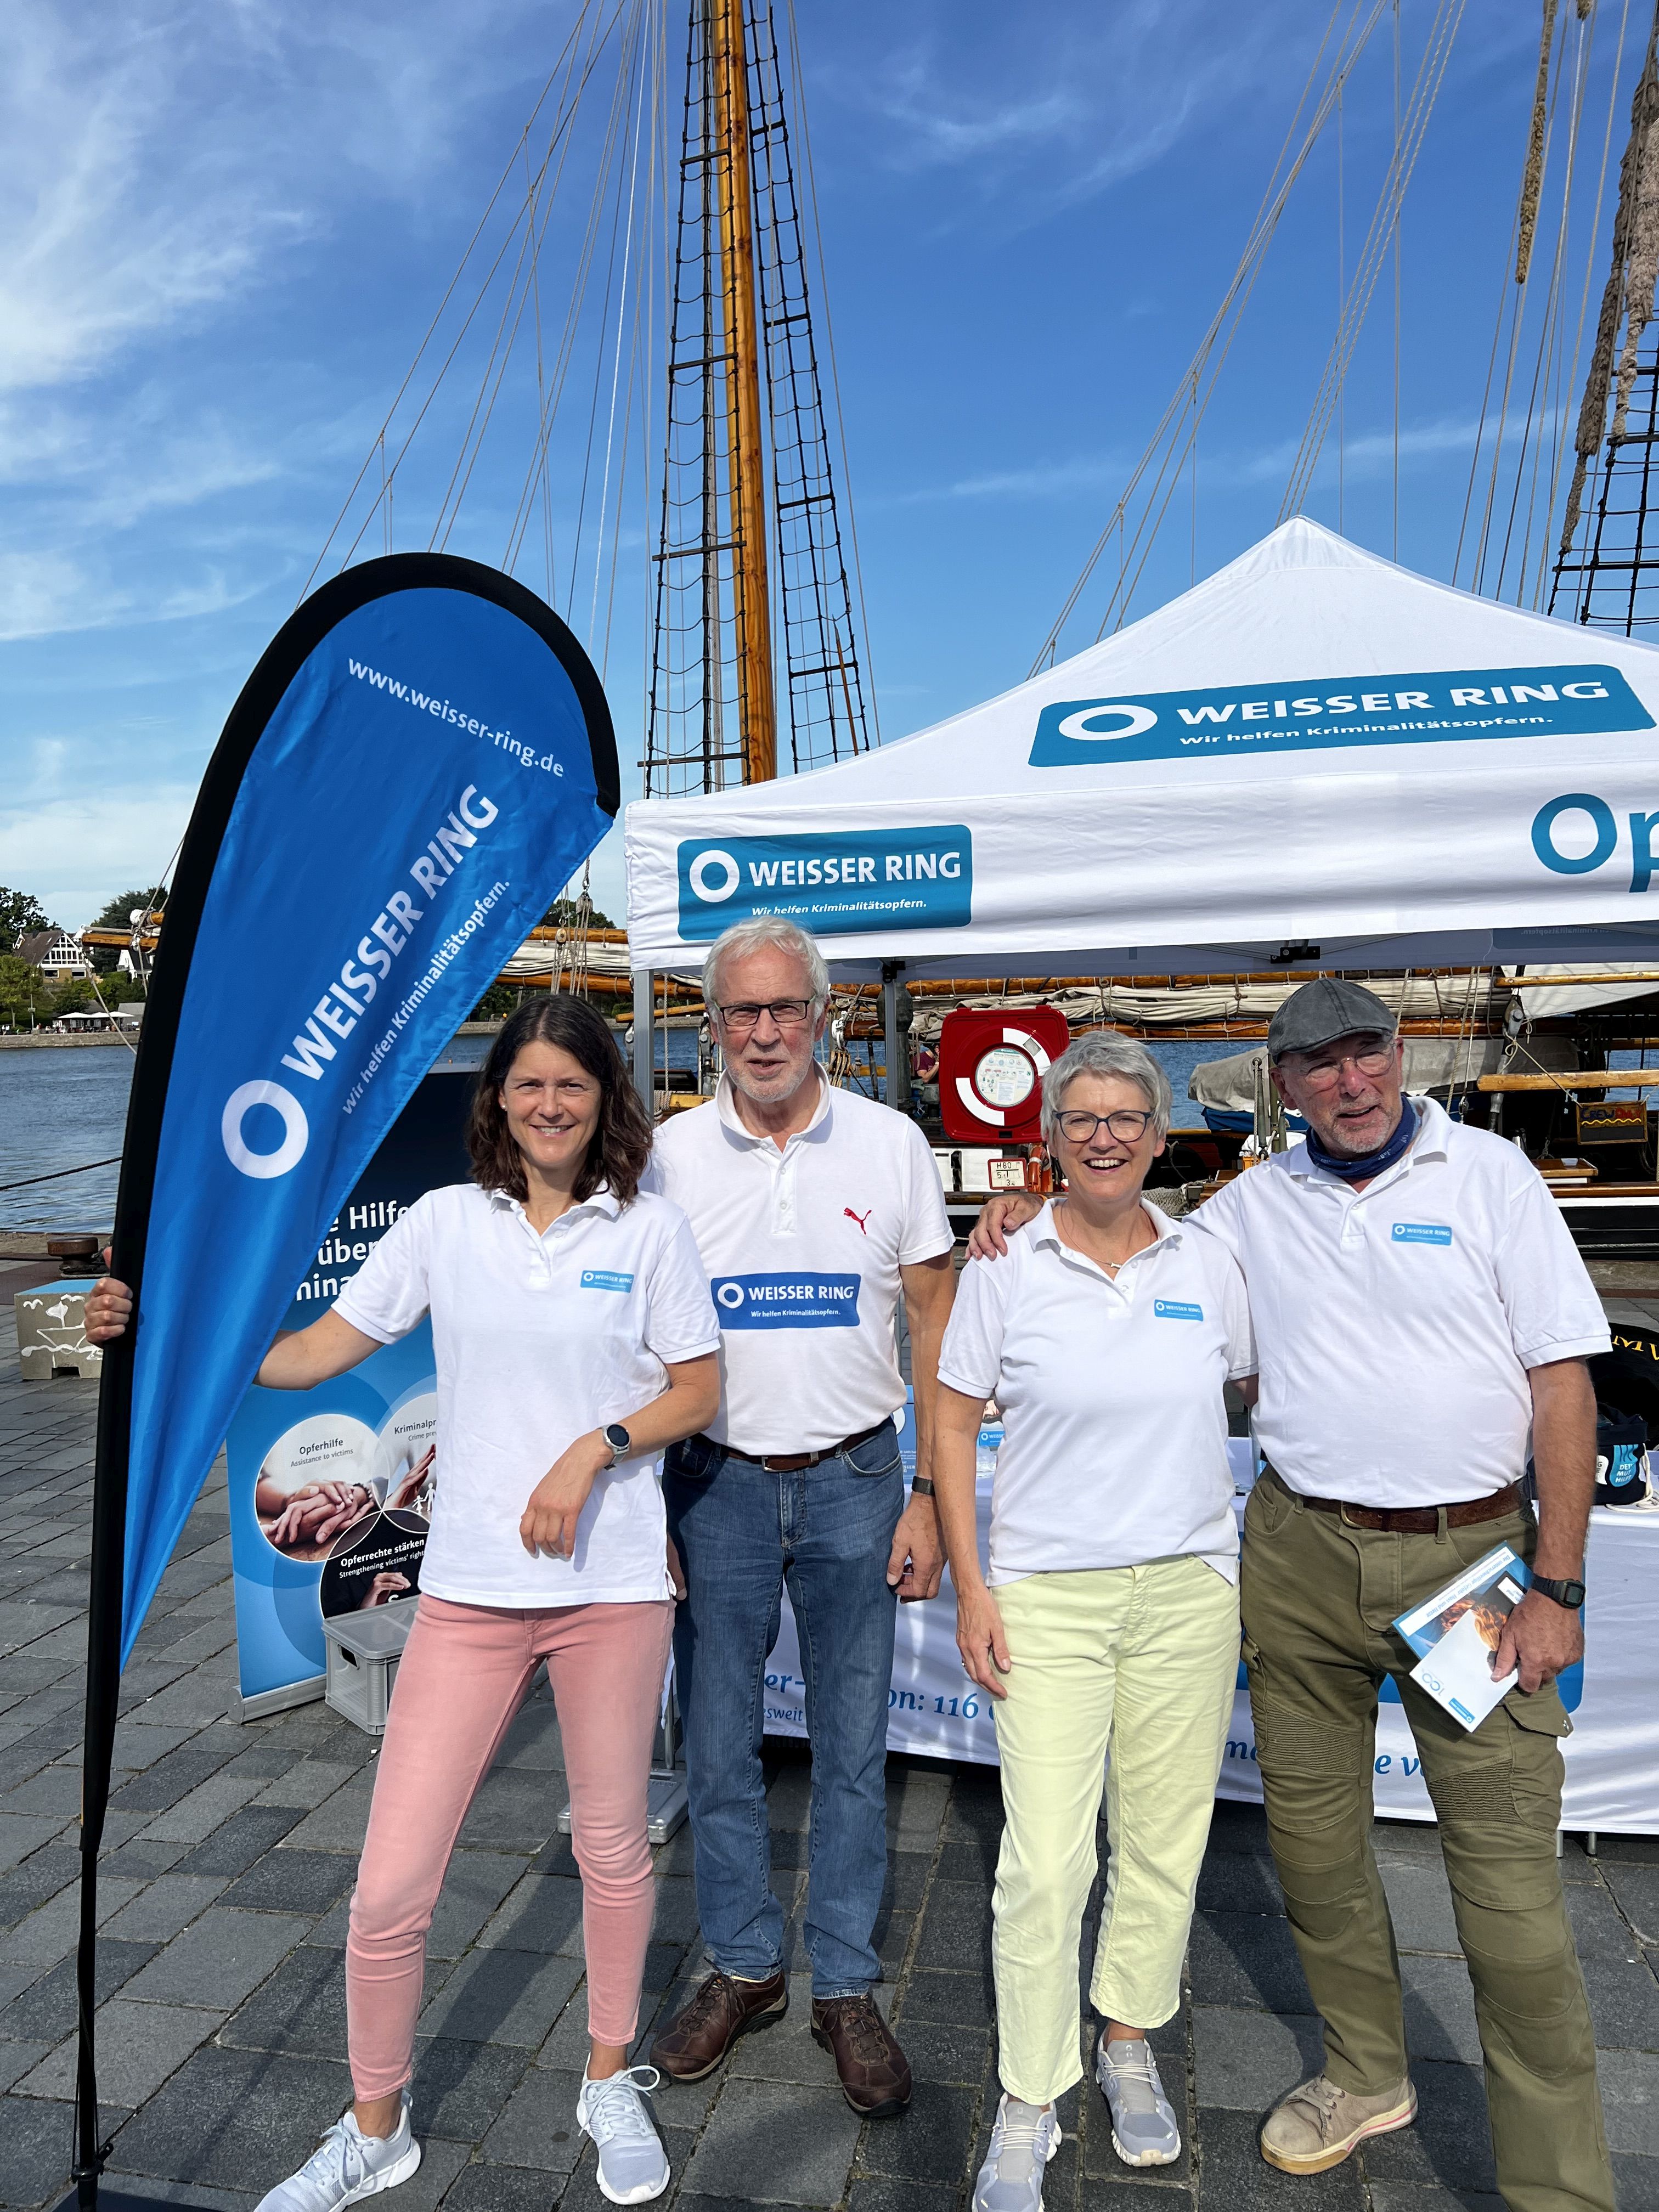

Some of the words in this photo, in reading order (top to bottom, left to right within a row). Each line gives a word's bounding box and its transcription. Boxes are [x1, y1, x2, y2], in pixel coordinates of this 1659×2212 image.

[1176, 690, 1435, 725] WEISSER
[1449, 681, 1610, 707] RING
[347, 658, 565, 778] www.weisser-ring.de
[1180, 736, 1221, 745] Wir
[1227, 730, 1300, 741] helfen
[1307, 715, 1554, 736] Kriminalitätsopfern.
[748, 856, 876, 887] WEISSER
[885, 851, 961, 882] RING
[752, 907, 772, 916] Wir
[774, 905, 809, 915] helfen
[811, 899, 927, 912] Kriminalitätsopfern.
[280, 890, 424, 1082] WEISSER
[410, 784, 499, 900] RING
[342, 1082, 364, 1115] Wir
[363, 1029, 398, 1084] helfen
[391, 881, 510, 1030] Kriminalitätsopfern.
[748, 1285, 815, 1301] WEISSER
[818, 1285, 855, 1300] RING
[782, 1308, 841, 1317] Kriminalitätsopfern.
[299, 1438, 343, 1455] Opferhilfe
[408, 1433, 425, 1441] Crime
[290, 1455, 321, 1468] Assistance
[331, 1448, 354, 1458] victims
[341, 1549, 392, 1568] Opferrechte
[394, 1539, 425, 1554] stärken
[339, 1562, 384, 1579] Strengthening
[934, 1693, 979, 1719] 116
[1401, 1757, 1425, 1776] v
